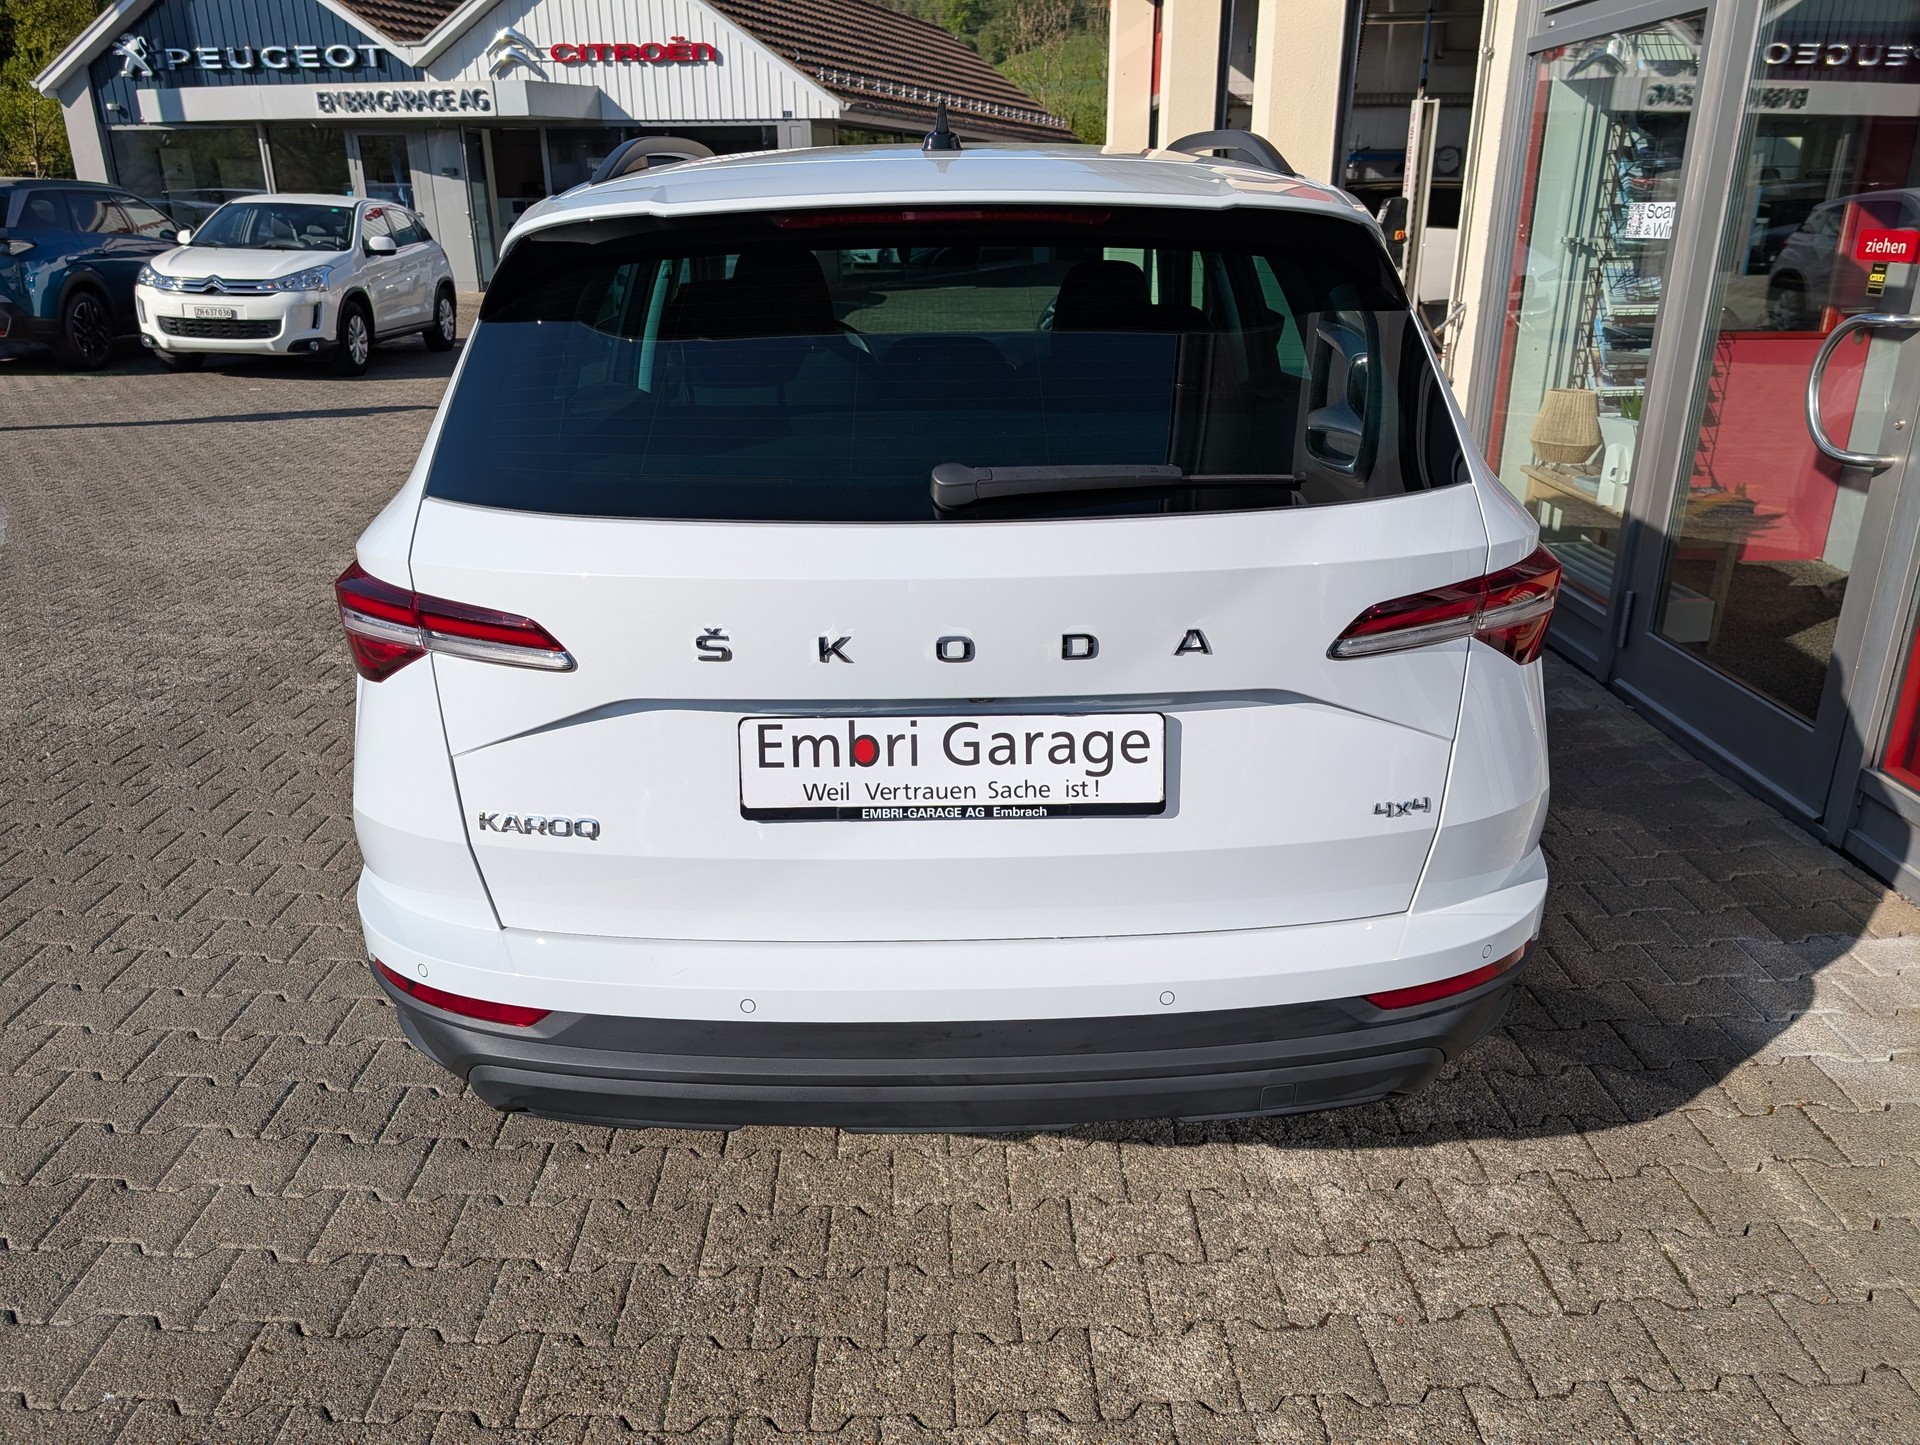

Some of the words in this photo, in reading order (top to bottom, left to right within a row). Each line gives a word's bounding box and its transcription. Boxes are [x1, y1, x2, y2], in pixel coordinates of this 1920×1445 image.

[165, 44, 385, 71] PEUGEOT
[1643, 224, 1651, 236] &
[1865, 237, 1907, 254] ziehen
[695, 626, 1214, 664] ŠKODA
[757, 720, 918, 769] Embri
[942, 720, 1151, 778] Garage
[802, 782, 850, 802] Weil
[865, 781, 977, 801] Vertrauen
[987, 779, 1051, 800] Sache
[861, 807, 963, 820] EMBRI-GARAGE
[965, 806, 986, 819] AG
[992, 806, 1048, 818] Embrach
[1373, 796, 1432, 818] 4x4
[478, 811, 601, 841] KAROQ
